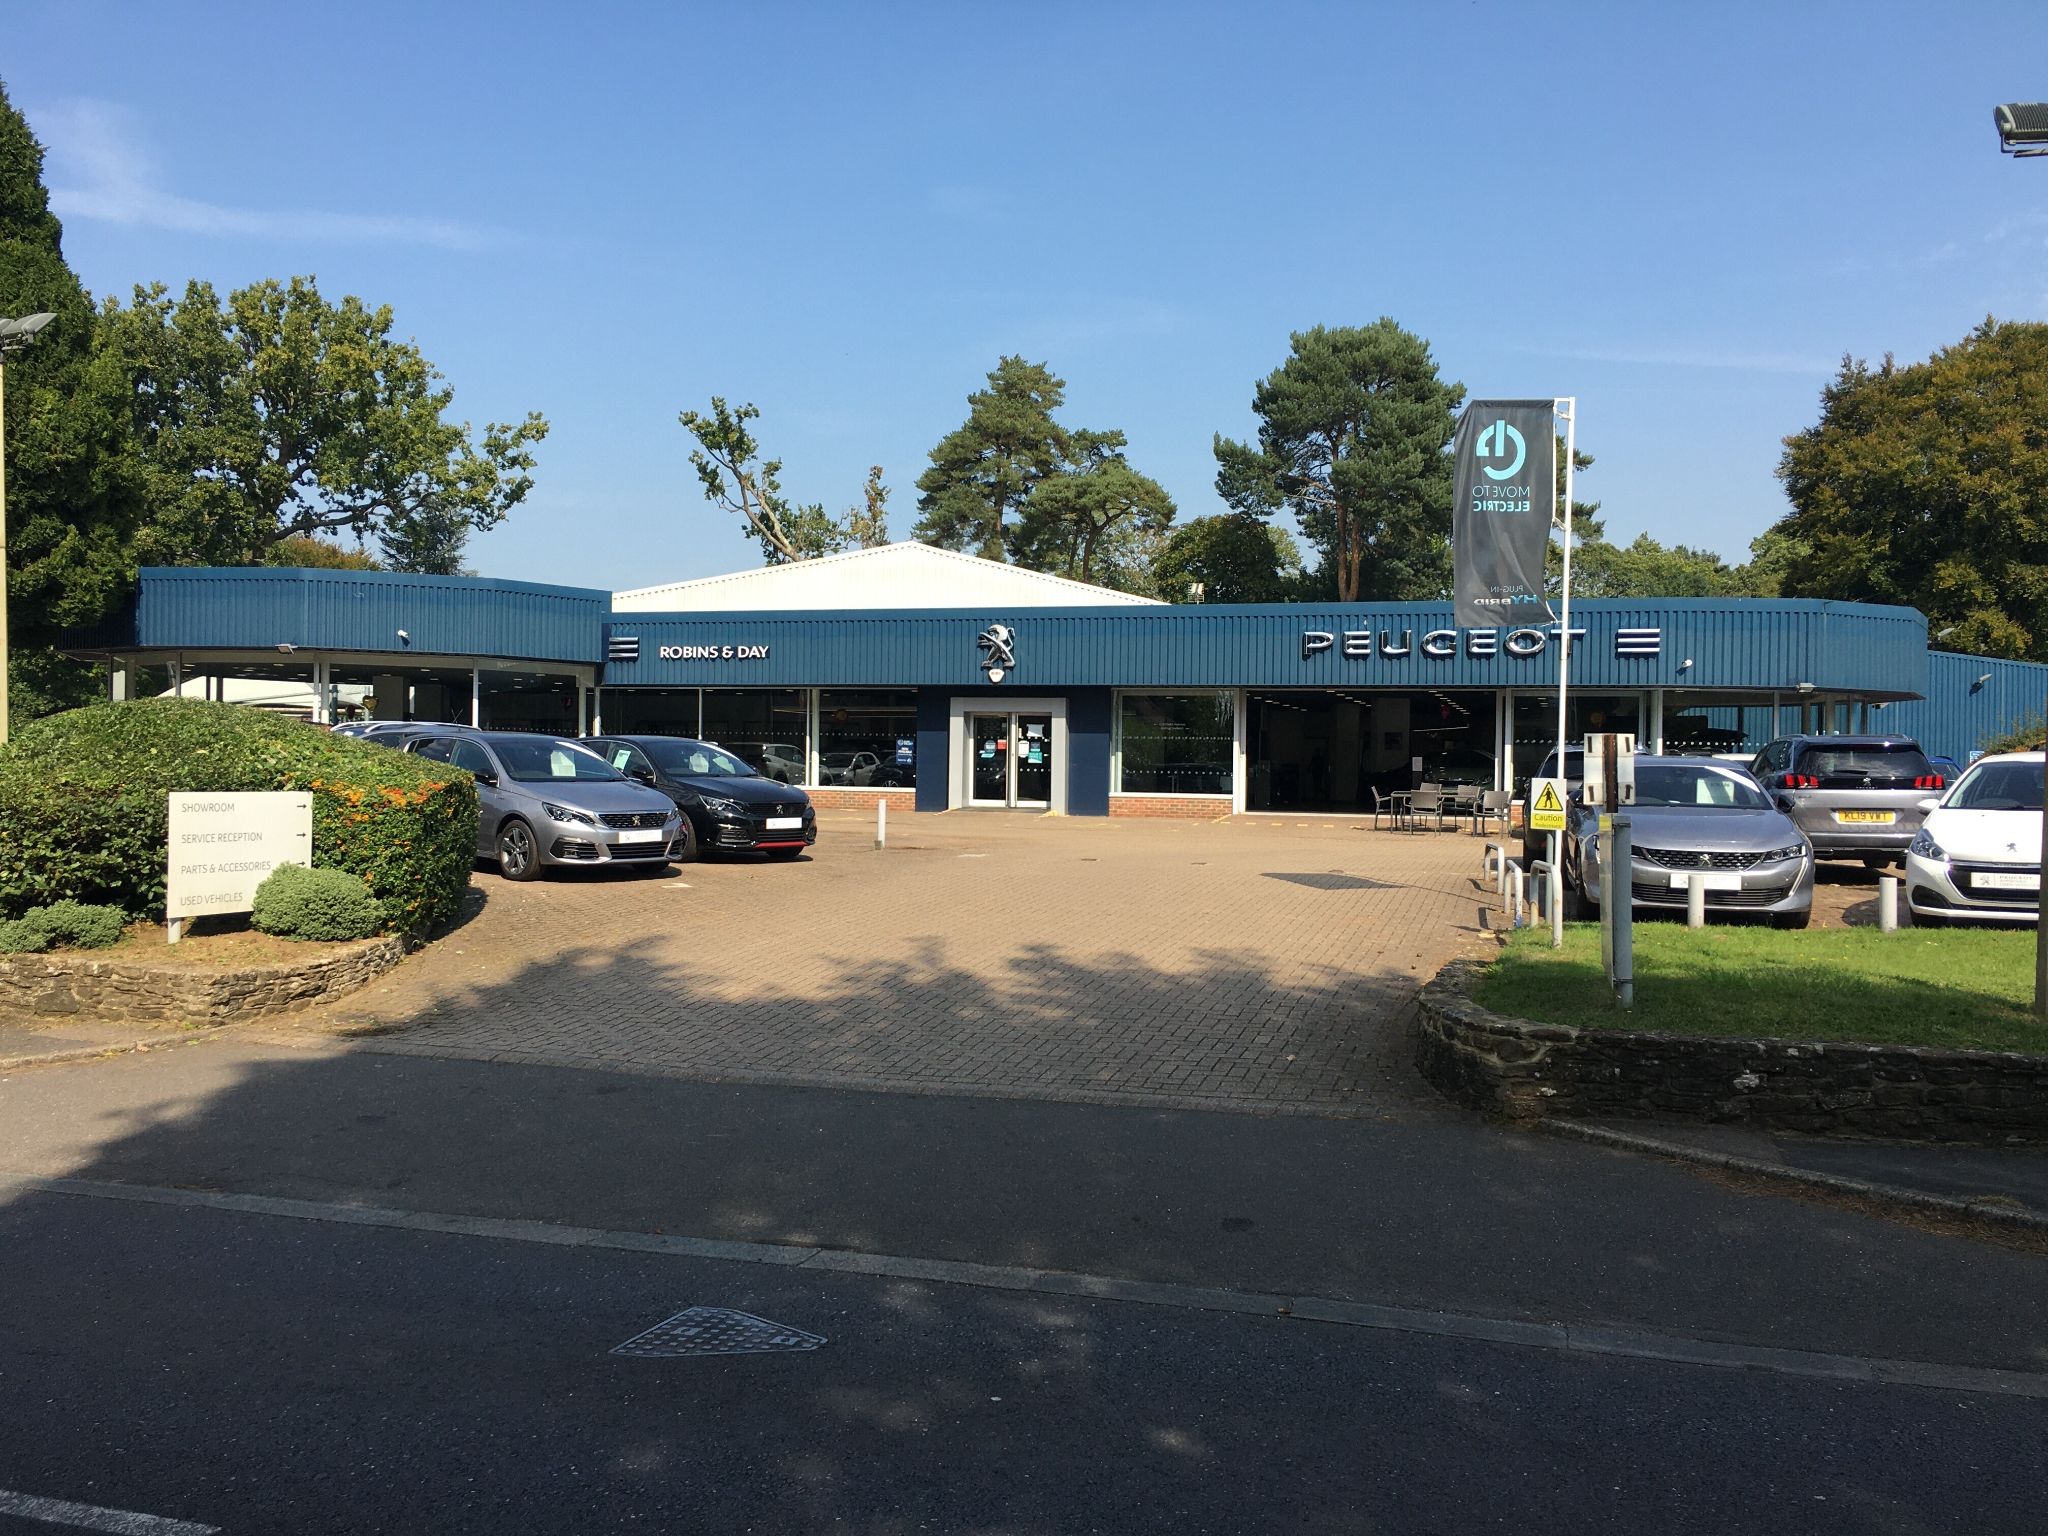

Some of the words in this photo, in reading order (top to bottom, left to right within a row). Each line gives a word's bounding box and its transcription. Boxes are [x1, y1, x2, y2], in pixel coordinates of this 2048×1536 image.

[1303, 629, 1586, 656] PEUGEOT
[660, 646, 718, 659] ROBINS
[722, 646, 734, 659] &
[738, 646, 769, 659] DAY
[181, 802, 235, 813] SHOWROOM
[1534, 814, 1563, 822] Caution
[181, 833, 216, 844] SERVICE
[217, 832, 263, 842] RECEPTION
[181, 864, 208, 875] PARTS
[209, 863, 216, 873] &
[218, 861, 271, 872] ACCESSORIES
[180, 895, 203, 907] USED
[204, 893, 243, 904] VEHICLES
